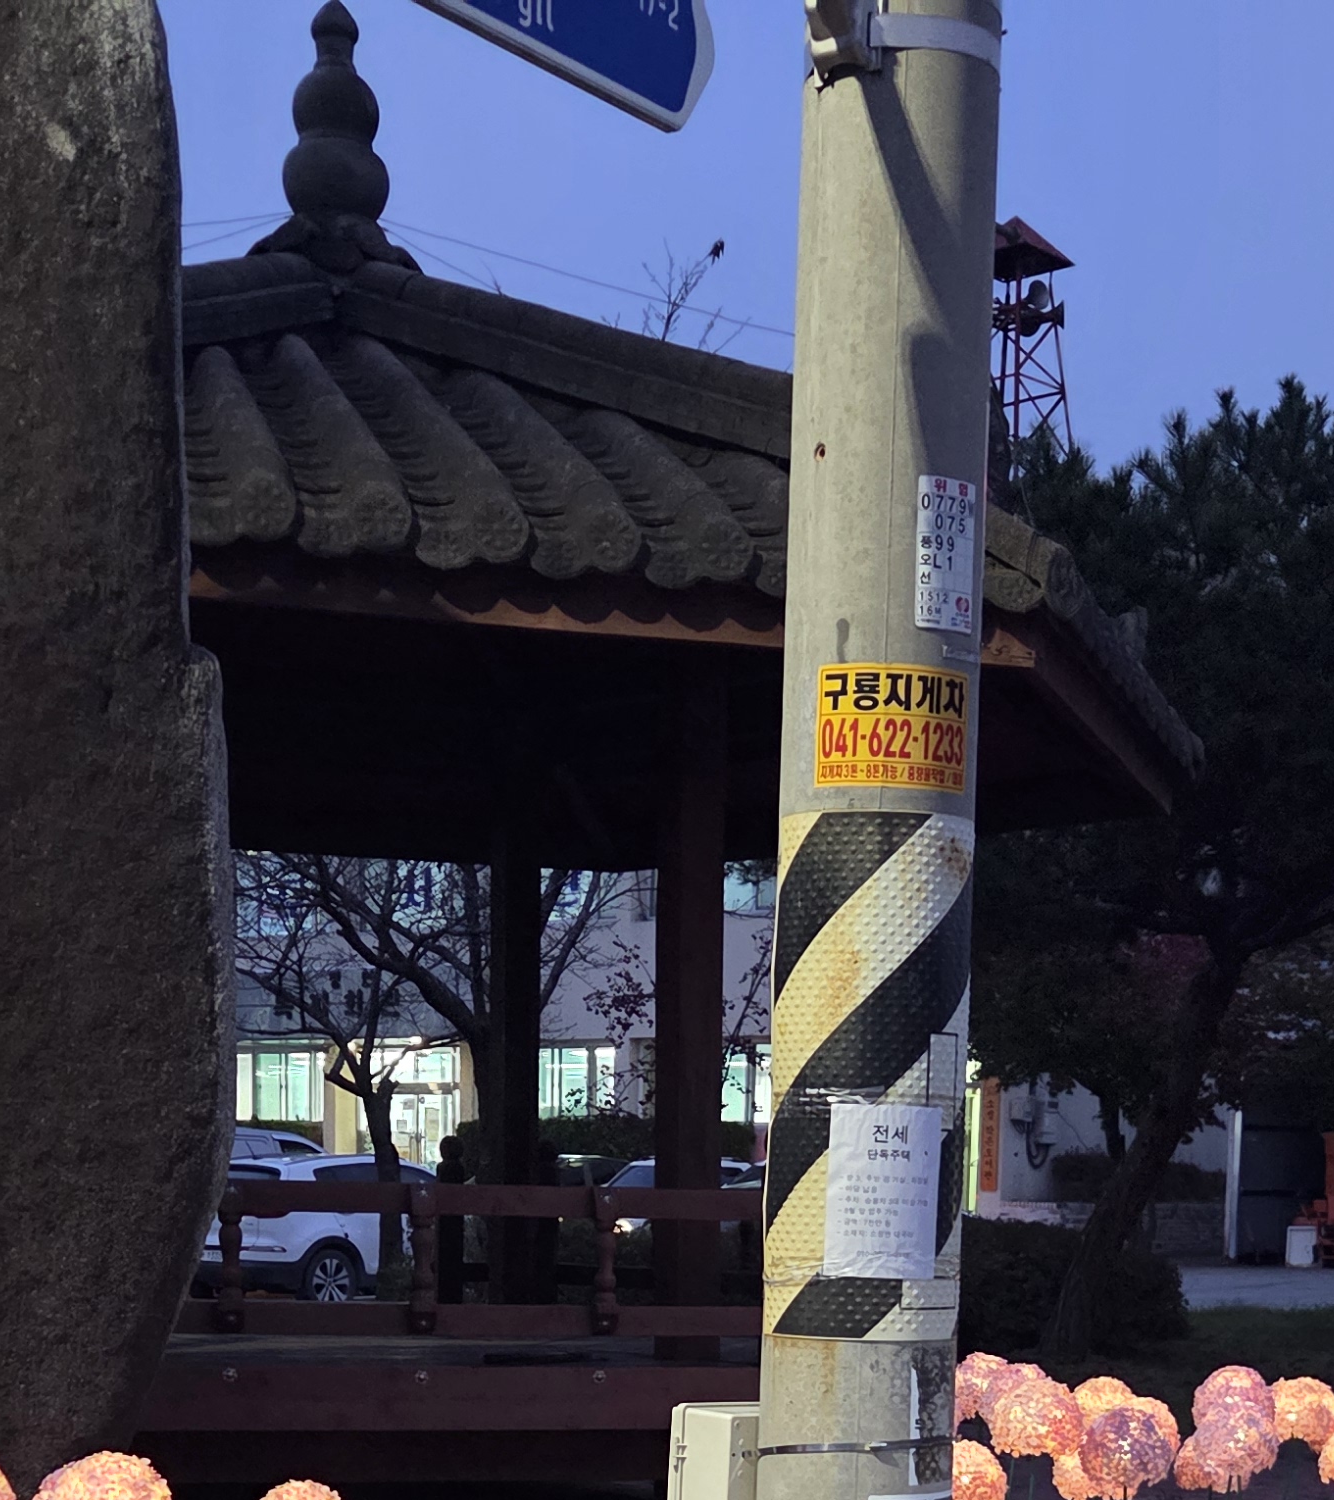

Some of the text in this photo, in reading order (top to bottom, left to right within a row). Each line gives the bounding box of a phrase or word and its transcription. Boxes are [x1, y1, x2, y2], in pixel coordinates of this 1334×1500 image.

[921, 493, 967, 515] 0779
[935, 513, 966, 534] 075
[919, 591, 948, 604] 1512
[824, 672, 965, 719] 구룡지게차
[821, 717, 964, 767] 041-622-1233
[872, 1125, 908, 1145] 전세
[867, 1149, 911, 1163] 단독주택
